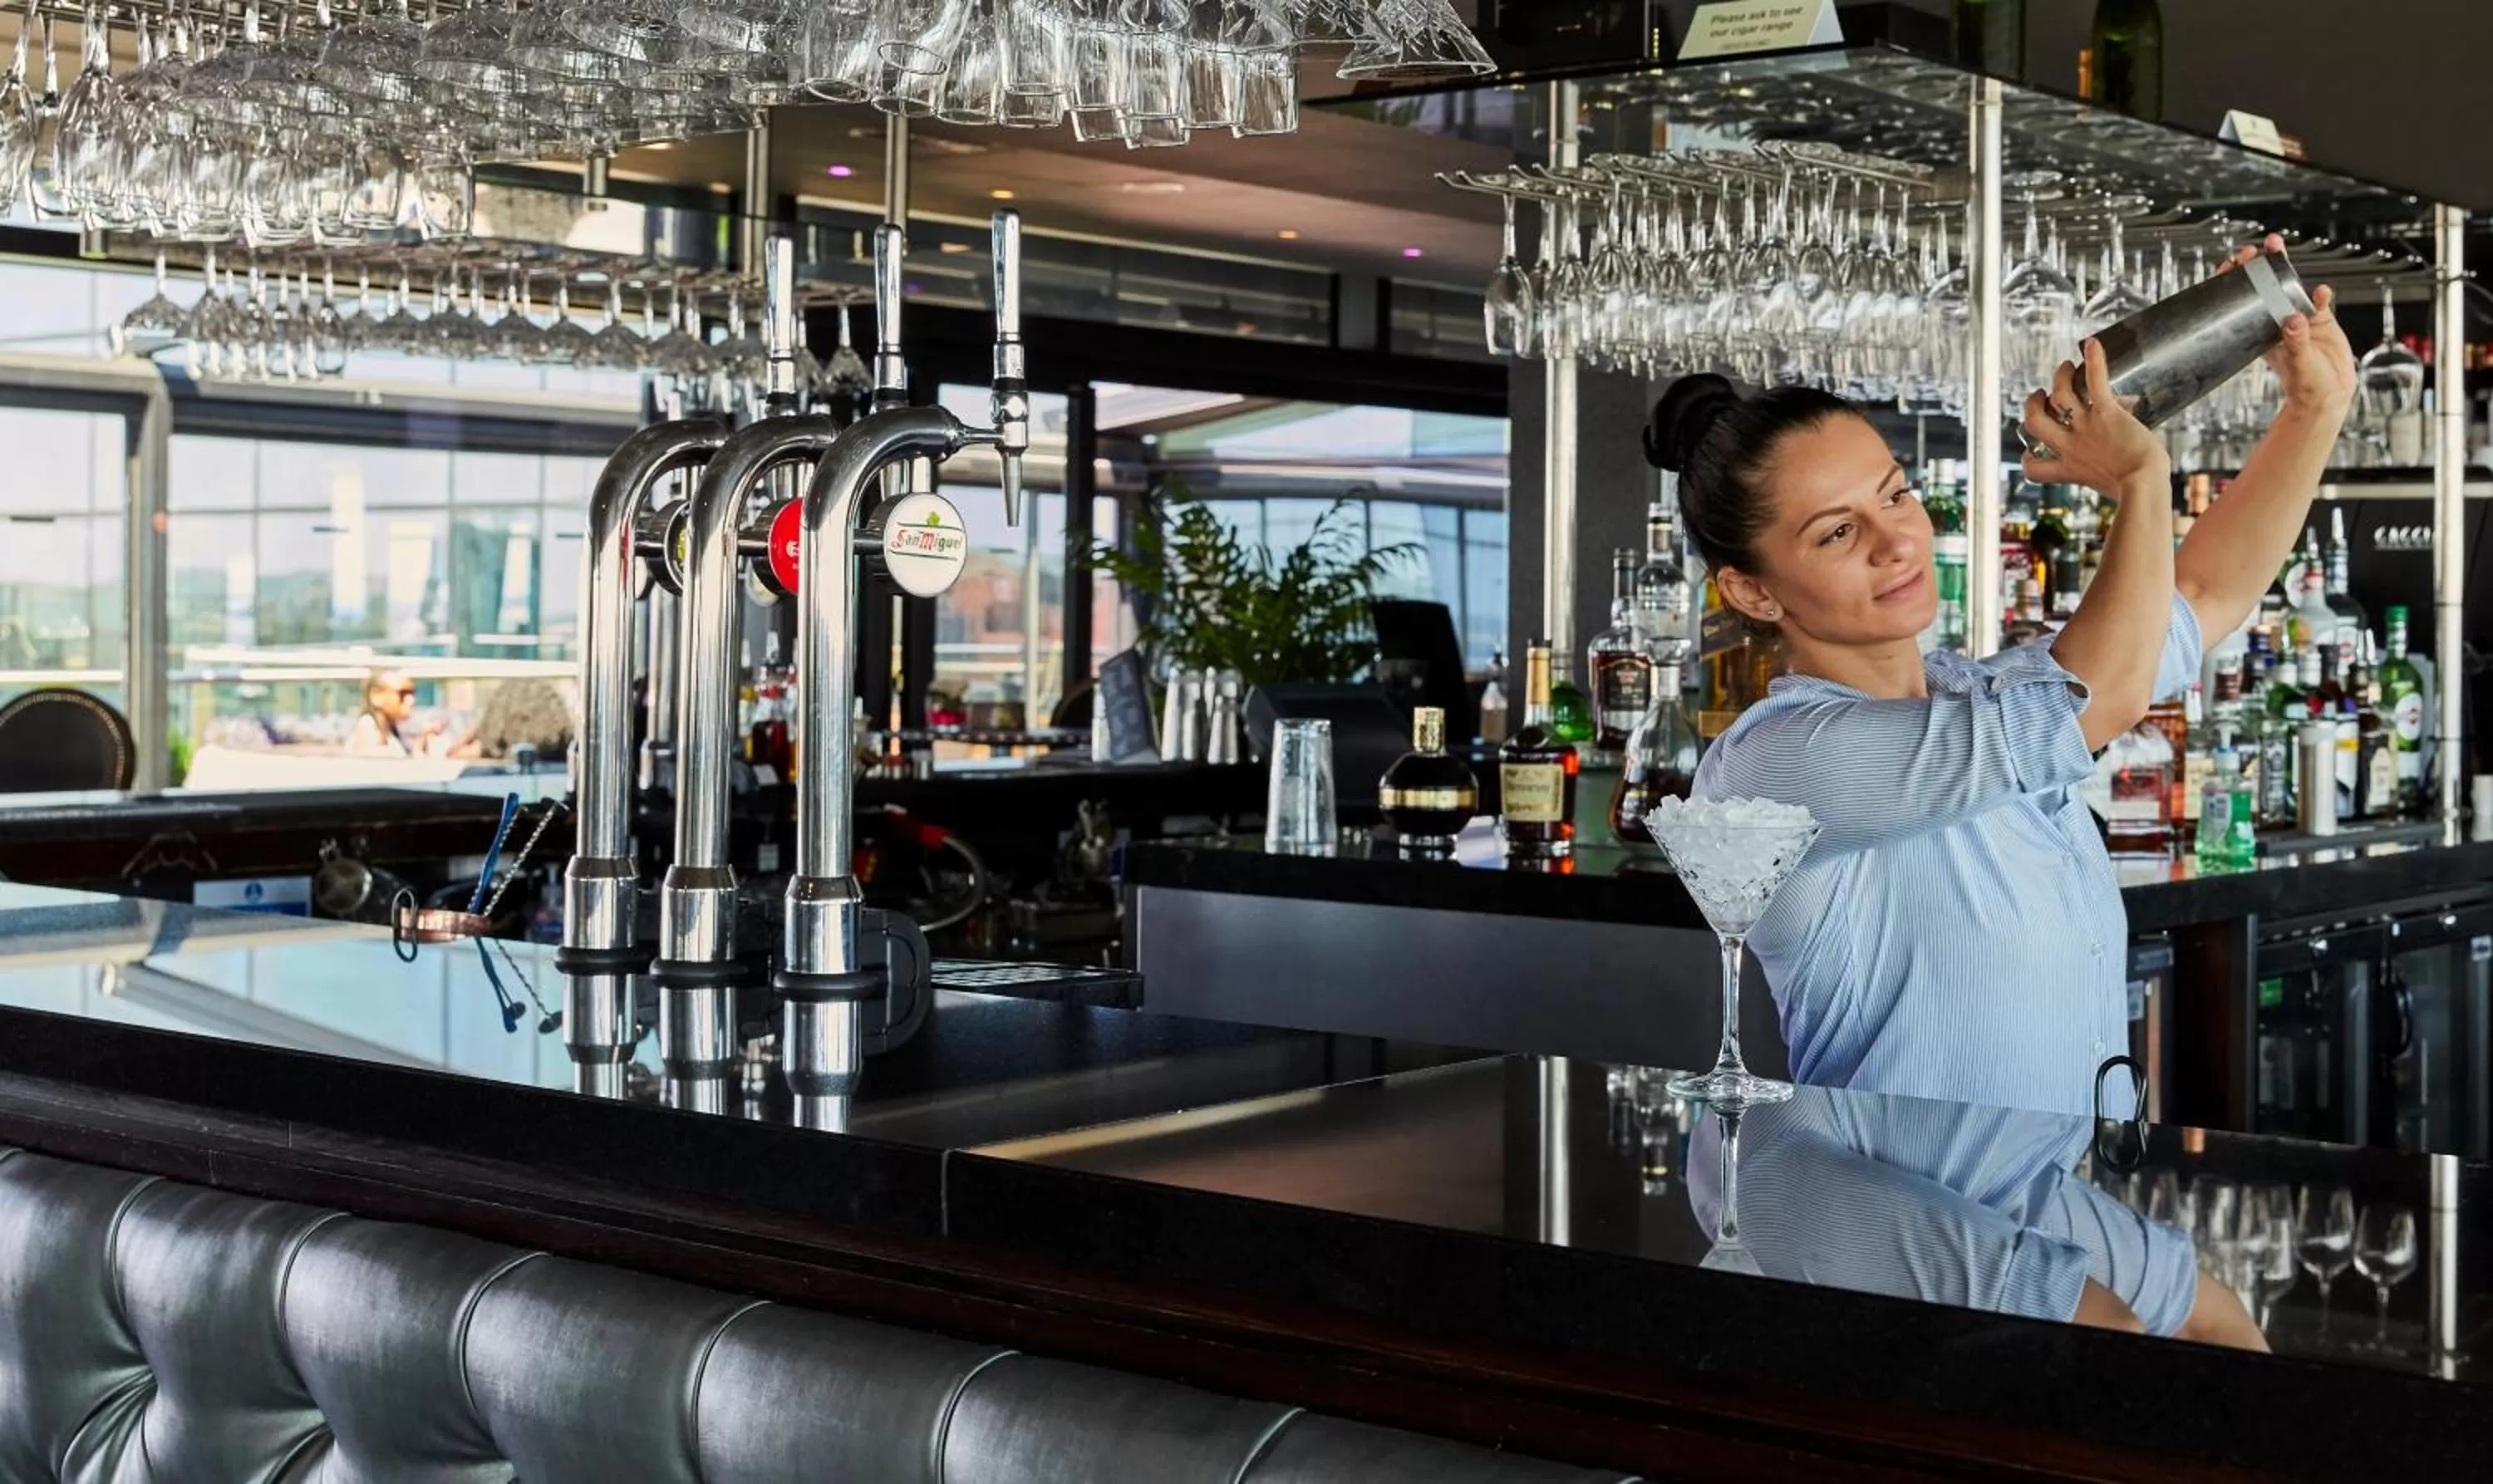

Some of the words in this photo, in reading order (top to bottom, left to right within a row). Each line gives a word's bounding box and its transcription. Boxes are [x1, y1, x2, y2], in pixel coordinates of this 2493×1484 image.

[1710, 13, 1746, 24] Please
[1748, 10, 1767, 20] ask
[1769, 8, 1782, 17] to
[1782, 6, 1804, 16] see
[1709, 28, 1729, 37] our
[1731, 24, 1759, 36] cigar
[1760, 21, 1794, 32] range
